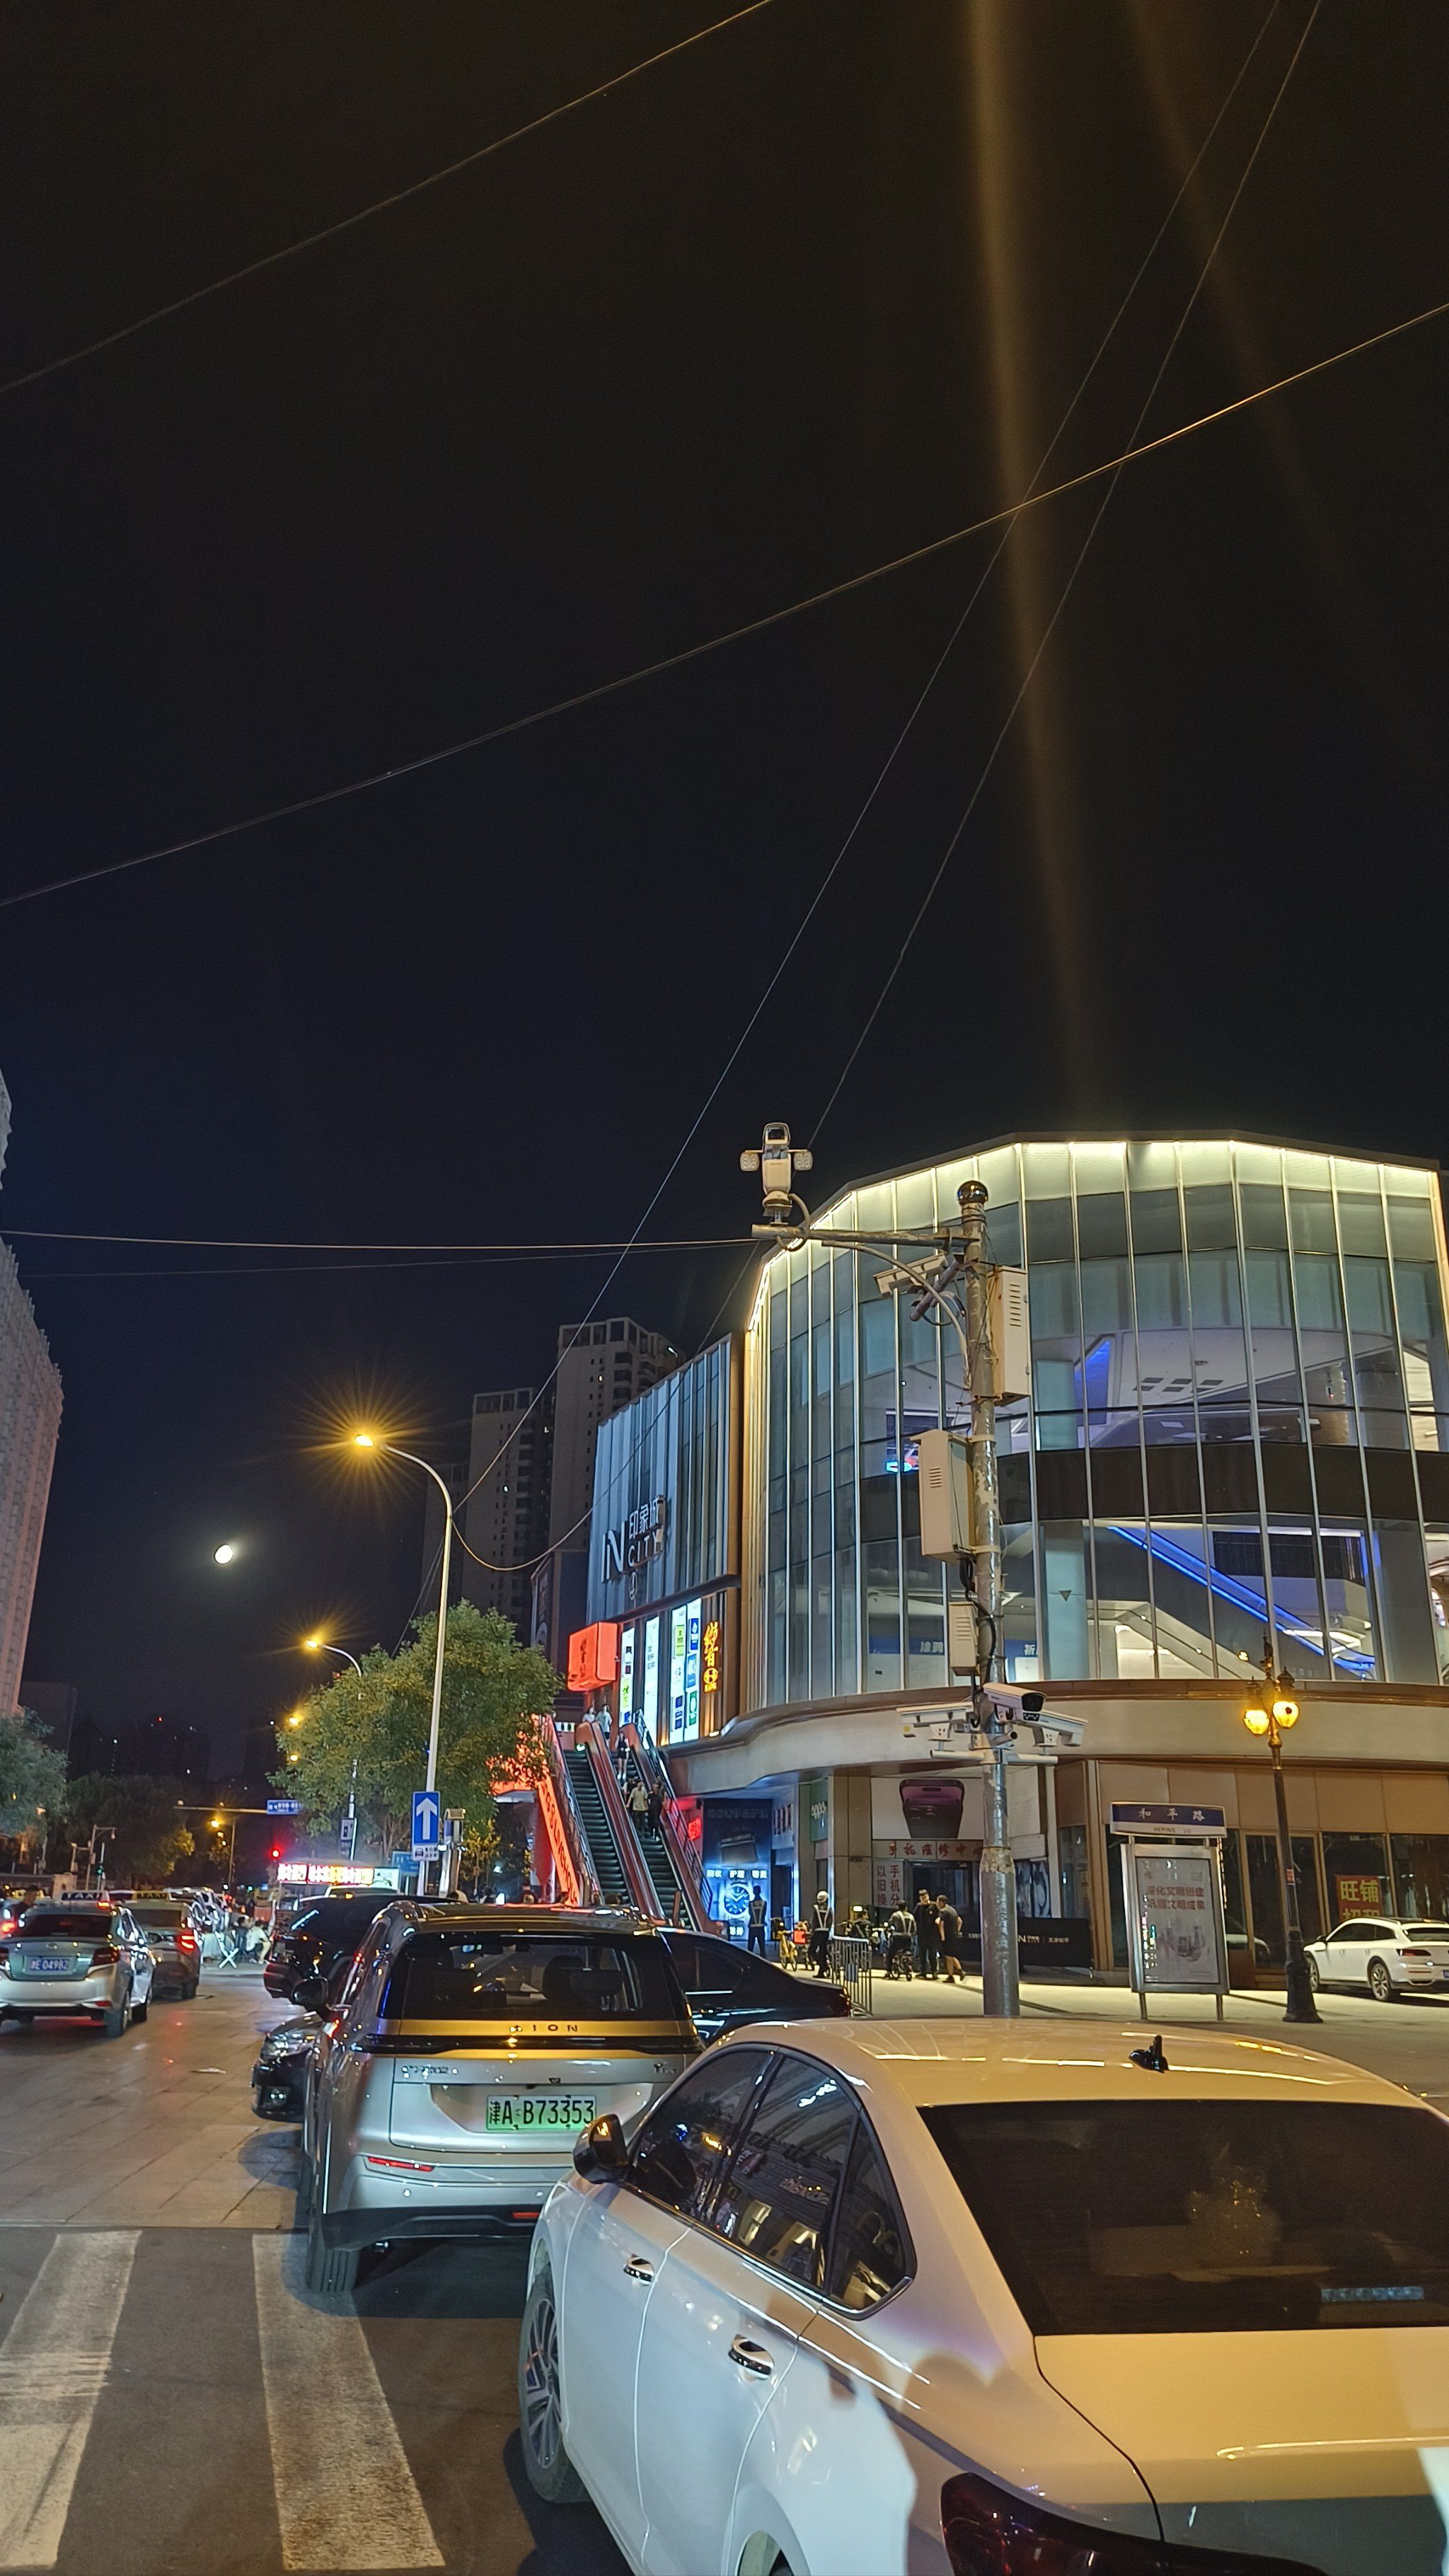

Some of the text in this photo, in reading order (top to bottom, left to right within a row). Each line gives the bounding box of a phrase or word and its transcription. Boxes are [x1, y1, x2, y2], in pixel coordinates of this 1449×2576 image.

[628, 1529, 662, 1567] CITY
[1138, 1807, 1206, 1822] 和平路
[1340, 1879, 1379, 1902] 旺铺
